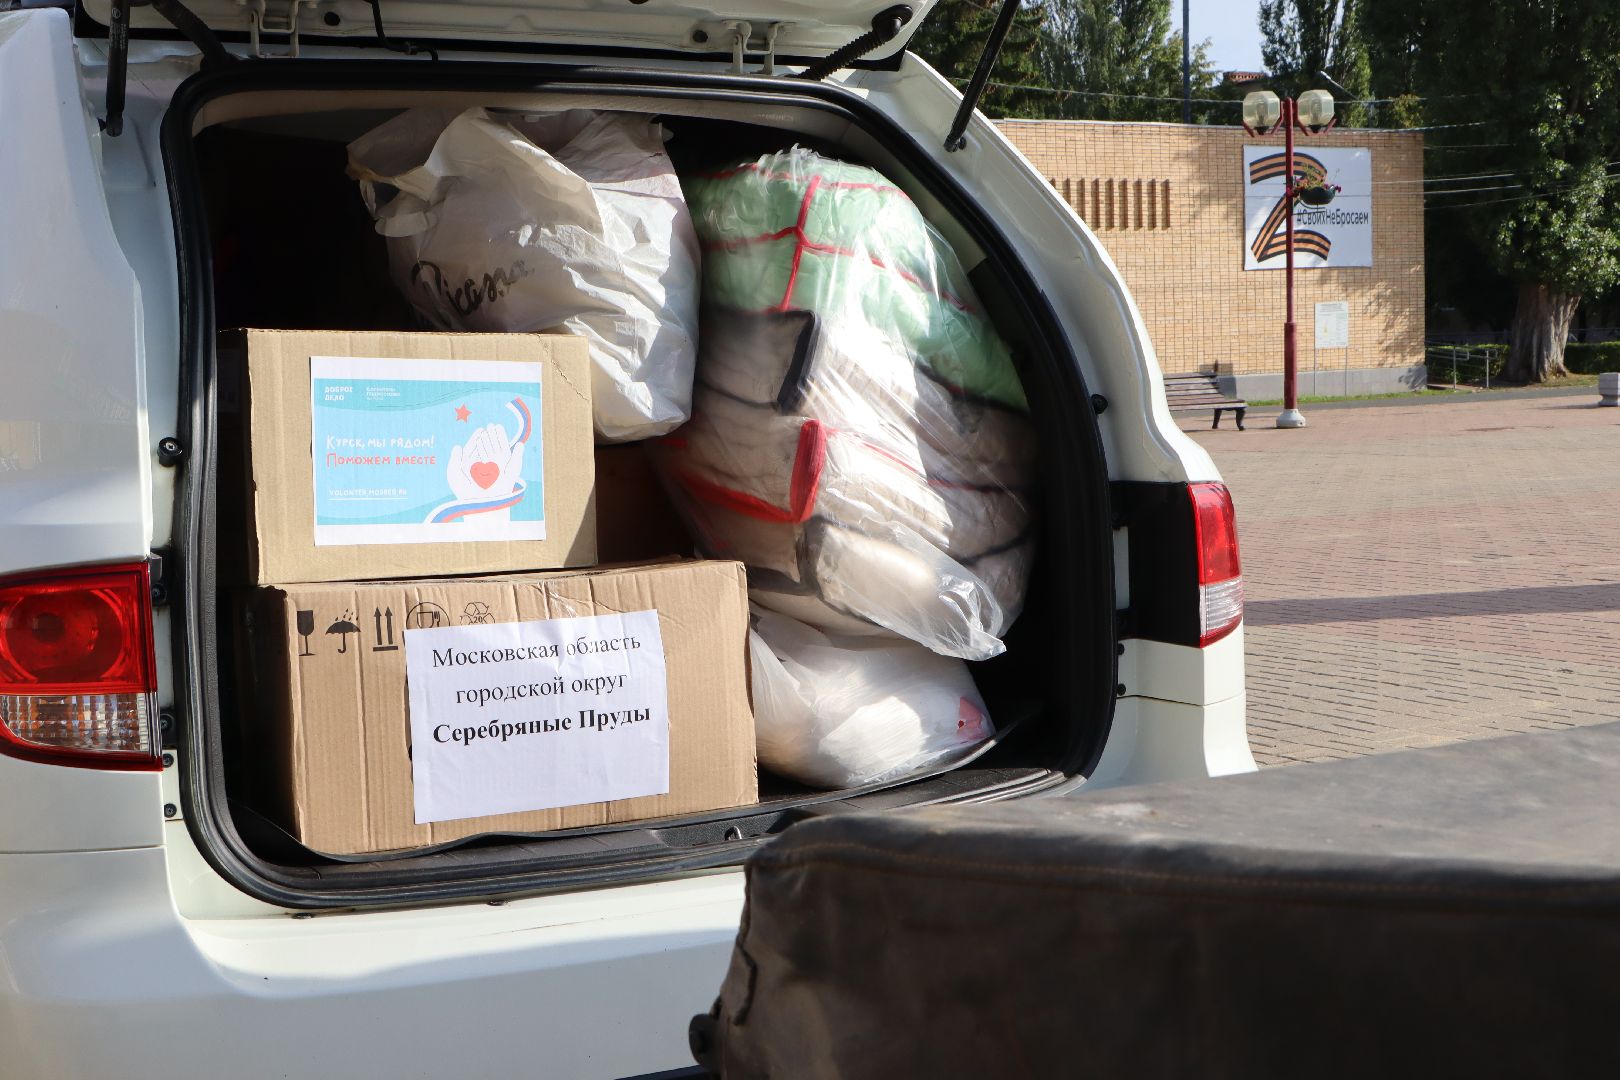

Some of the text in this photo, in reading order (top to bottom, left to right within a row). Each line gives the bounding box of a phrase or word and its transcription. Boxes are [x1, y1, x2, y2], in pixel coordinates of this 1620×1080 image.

[432, 634, 641, 667] Московская область
[456, 675, 627, 706] городской округ
[433, 707, 651, 745] Серебряные Пруды
